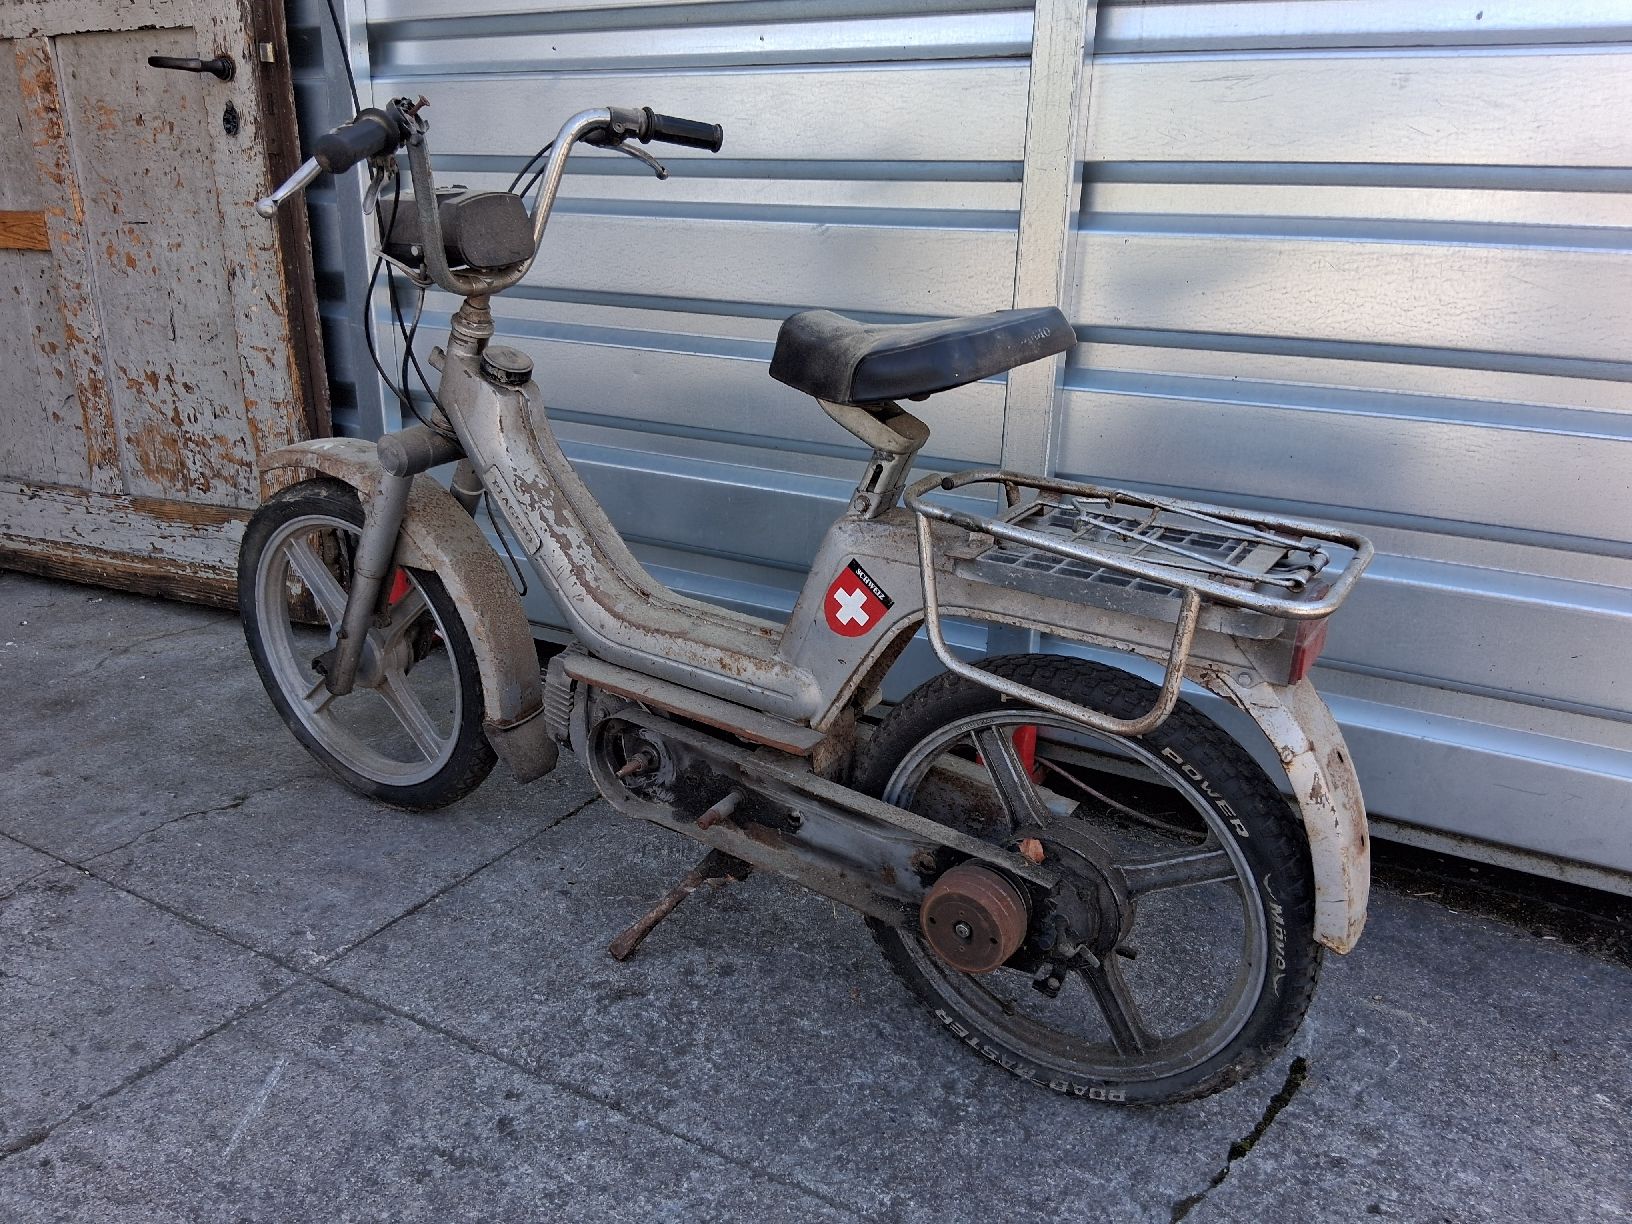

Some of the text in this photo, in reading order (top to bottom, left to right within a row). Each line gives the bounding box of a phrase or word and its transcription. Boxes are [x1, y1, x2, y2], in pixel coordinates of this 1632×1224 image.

[855, 568, 886, 601] SCHWEIZ
[1161, 747, 1250, 838] POWER
[934, 1008, 1126, 1102] ROAD MASTER
